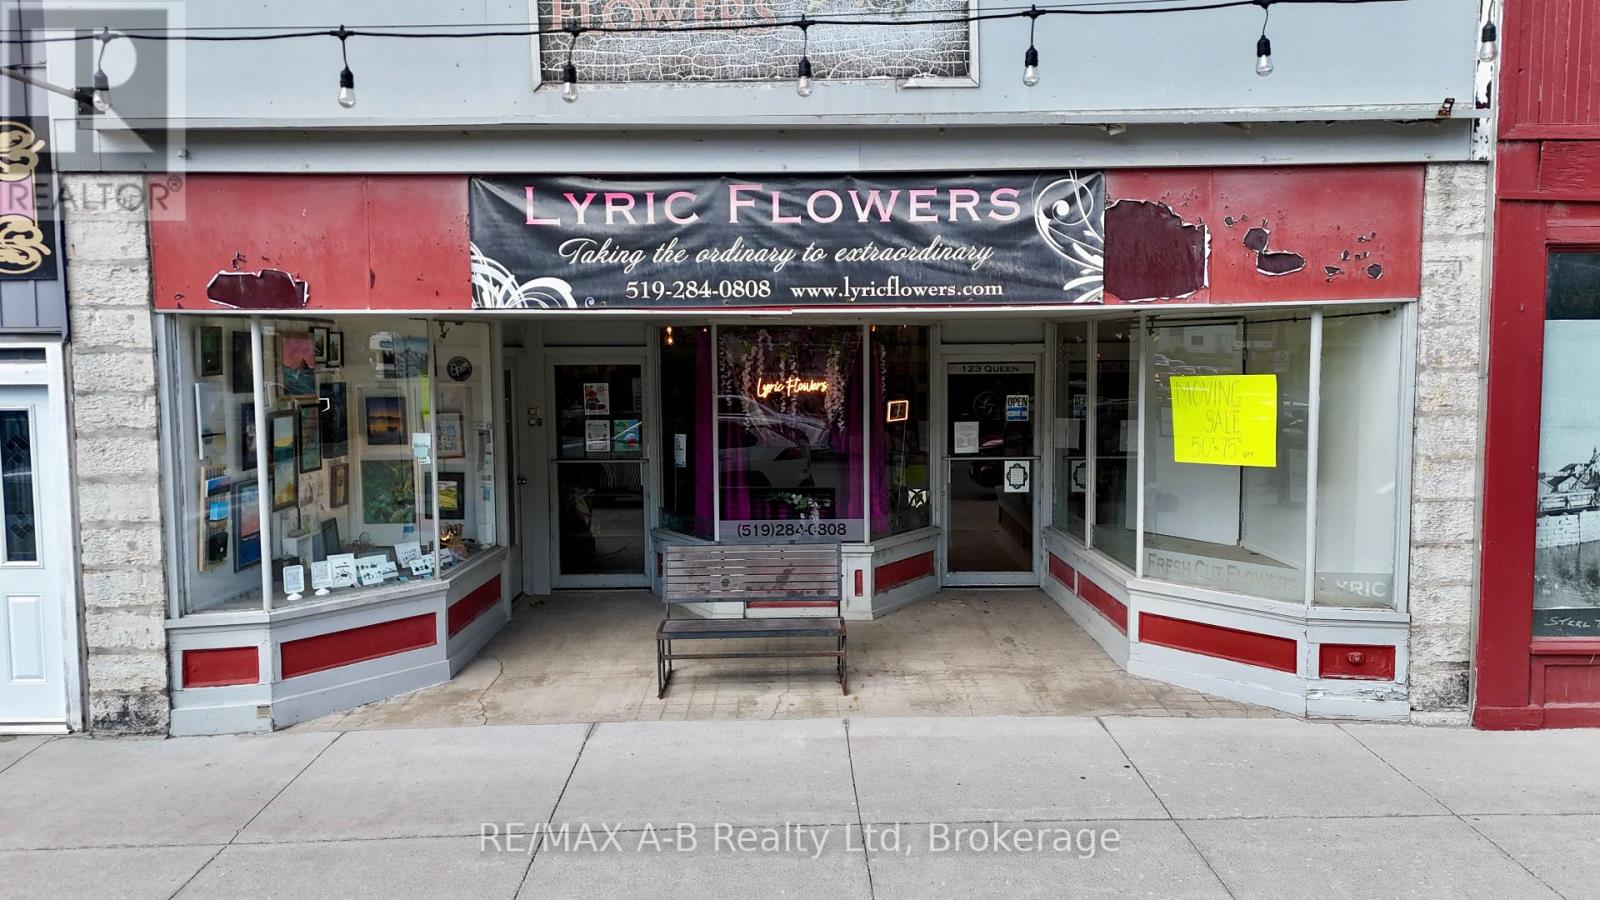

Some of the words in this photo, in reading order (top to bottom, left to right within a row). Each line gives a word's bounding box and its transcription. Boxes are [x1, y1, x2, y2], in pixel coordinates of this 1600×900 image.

[558, 237, 647, 274] Taking
[652, 236, 689, 264] the
[695, 236, 797, 273] ordinary
[801, 241, 828, 262] to
[833, 234, 995, 271] extraordinary
[625, 279, 772, 300] 519-284-0808
[790, 275, 1004, 301] www.lyricflowers.com
[962, 365, 981, 373] 123
[757, 377, 785, 398] Lyric
[785, 376, 829, 397] Flowers
[1175, 380, 1242, 407] MOVING
[1008, 396, 1028, 407] OPEN
[1205, 408, 1242, 434] SALE
